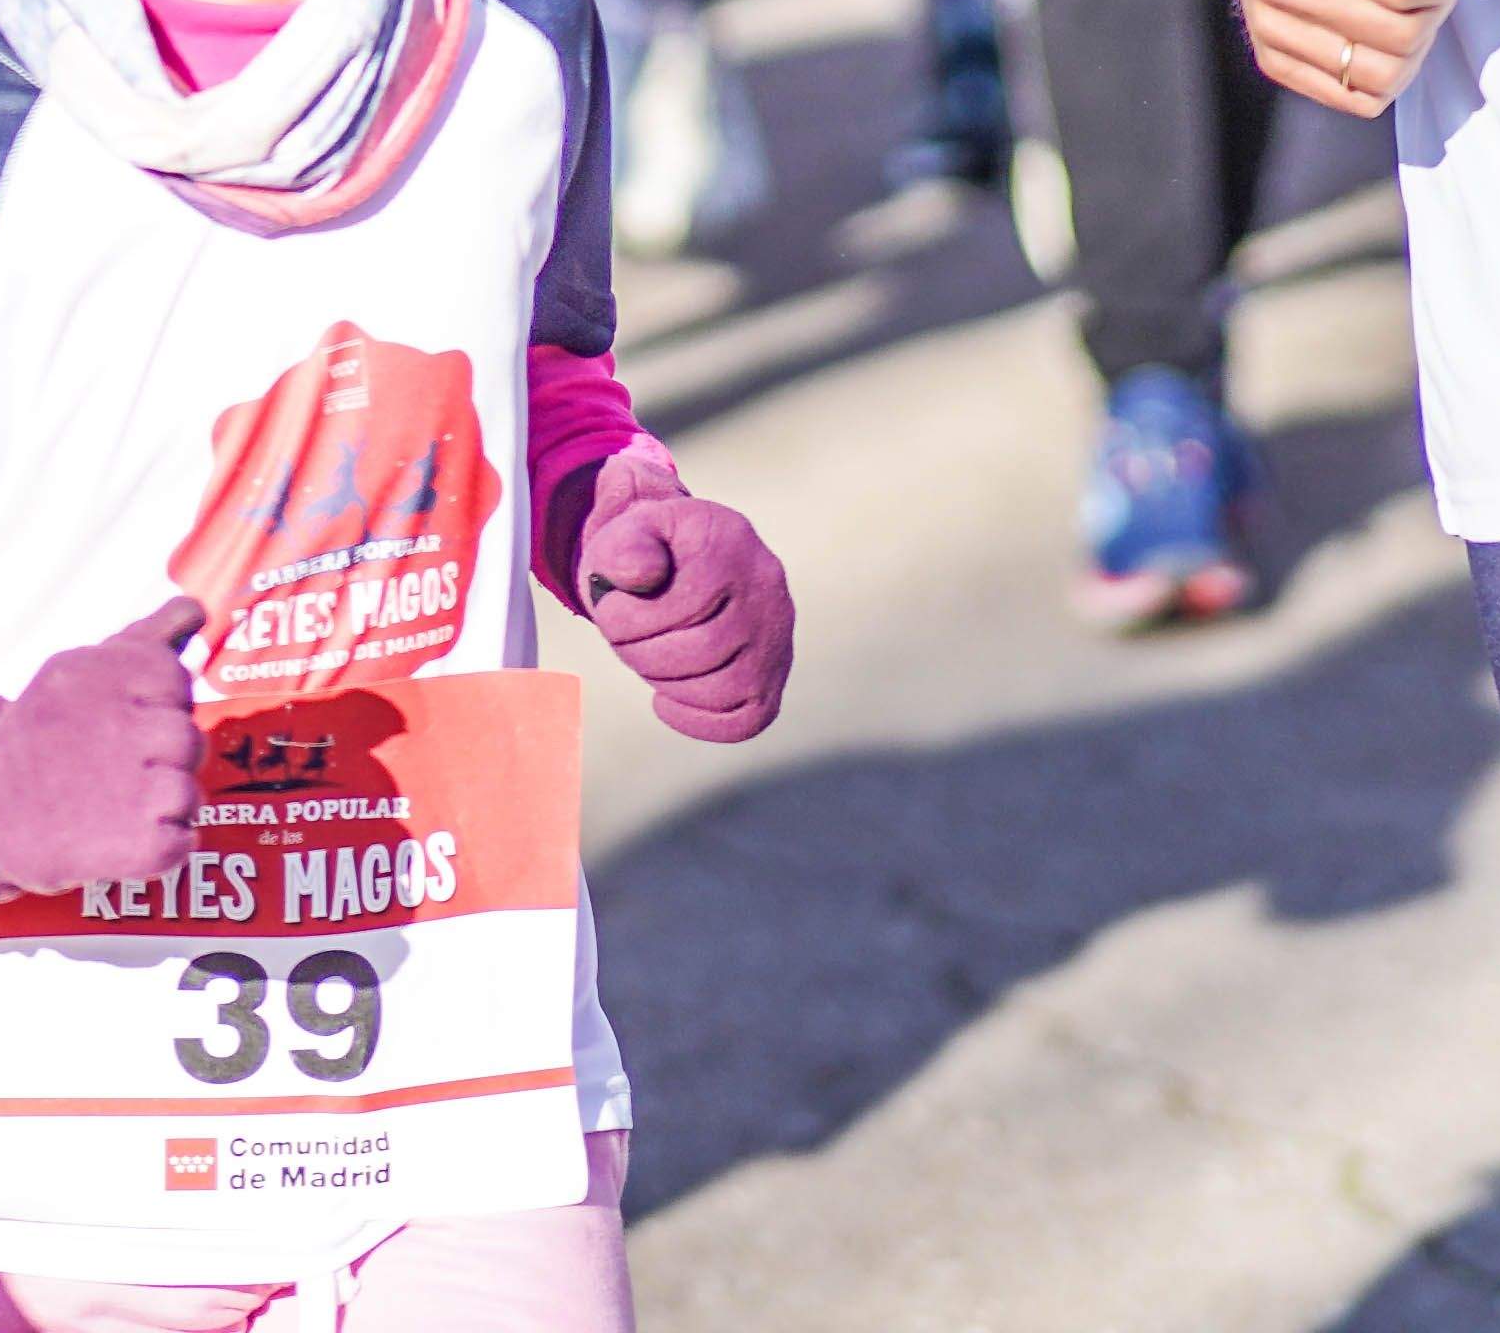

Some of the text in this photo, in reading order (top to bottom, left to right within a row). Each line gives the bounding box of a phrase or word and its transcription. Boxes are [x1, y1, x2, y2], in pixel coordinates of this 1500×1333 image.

[252, 550, 351, 591] CARRERA
[349, 561, 458, 635] MAGOS
[354, 641, 381, 660] DE
[385, 625, 454, 655] MADRID
[287, 797, 411, 824] POPULAR
[258, 831, 304, 846] de los
[81, 831, 456, 923] REYES MAGOS
[174, 950, 382, 1084] 39
[230, 1132, 390, 1157] Comunidad
[230, 1163, 391, 1190] de Madrid
